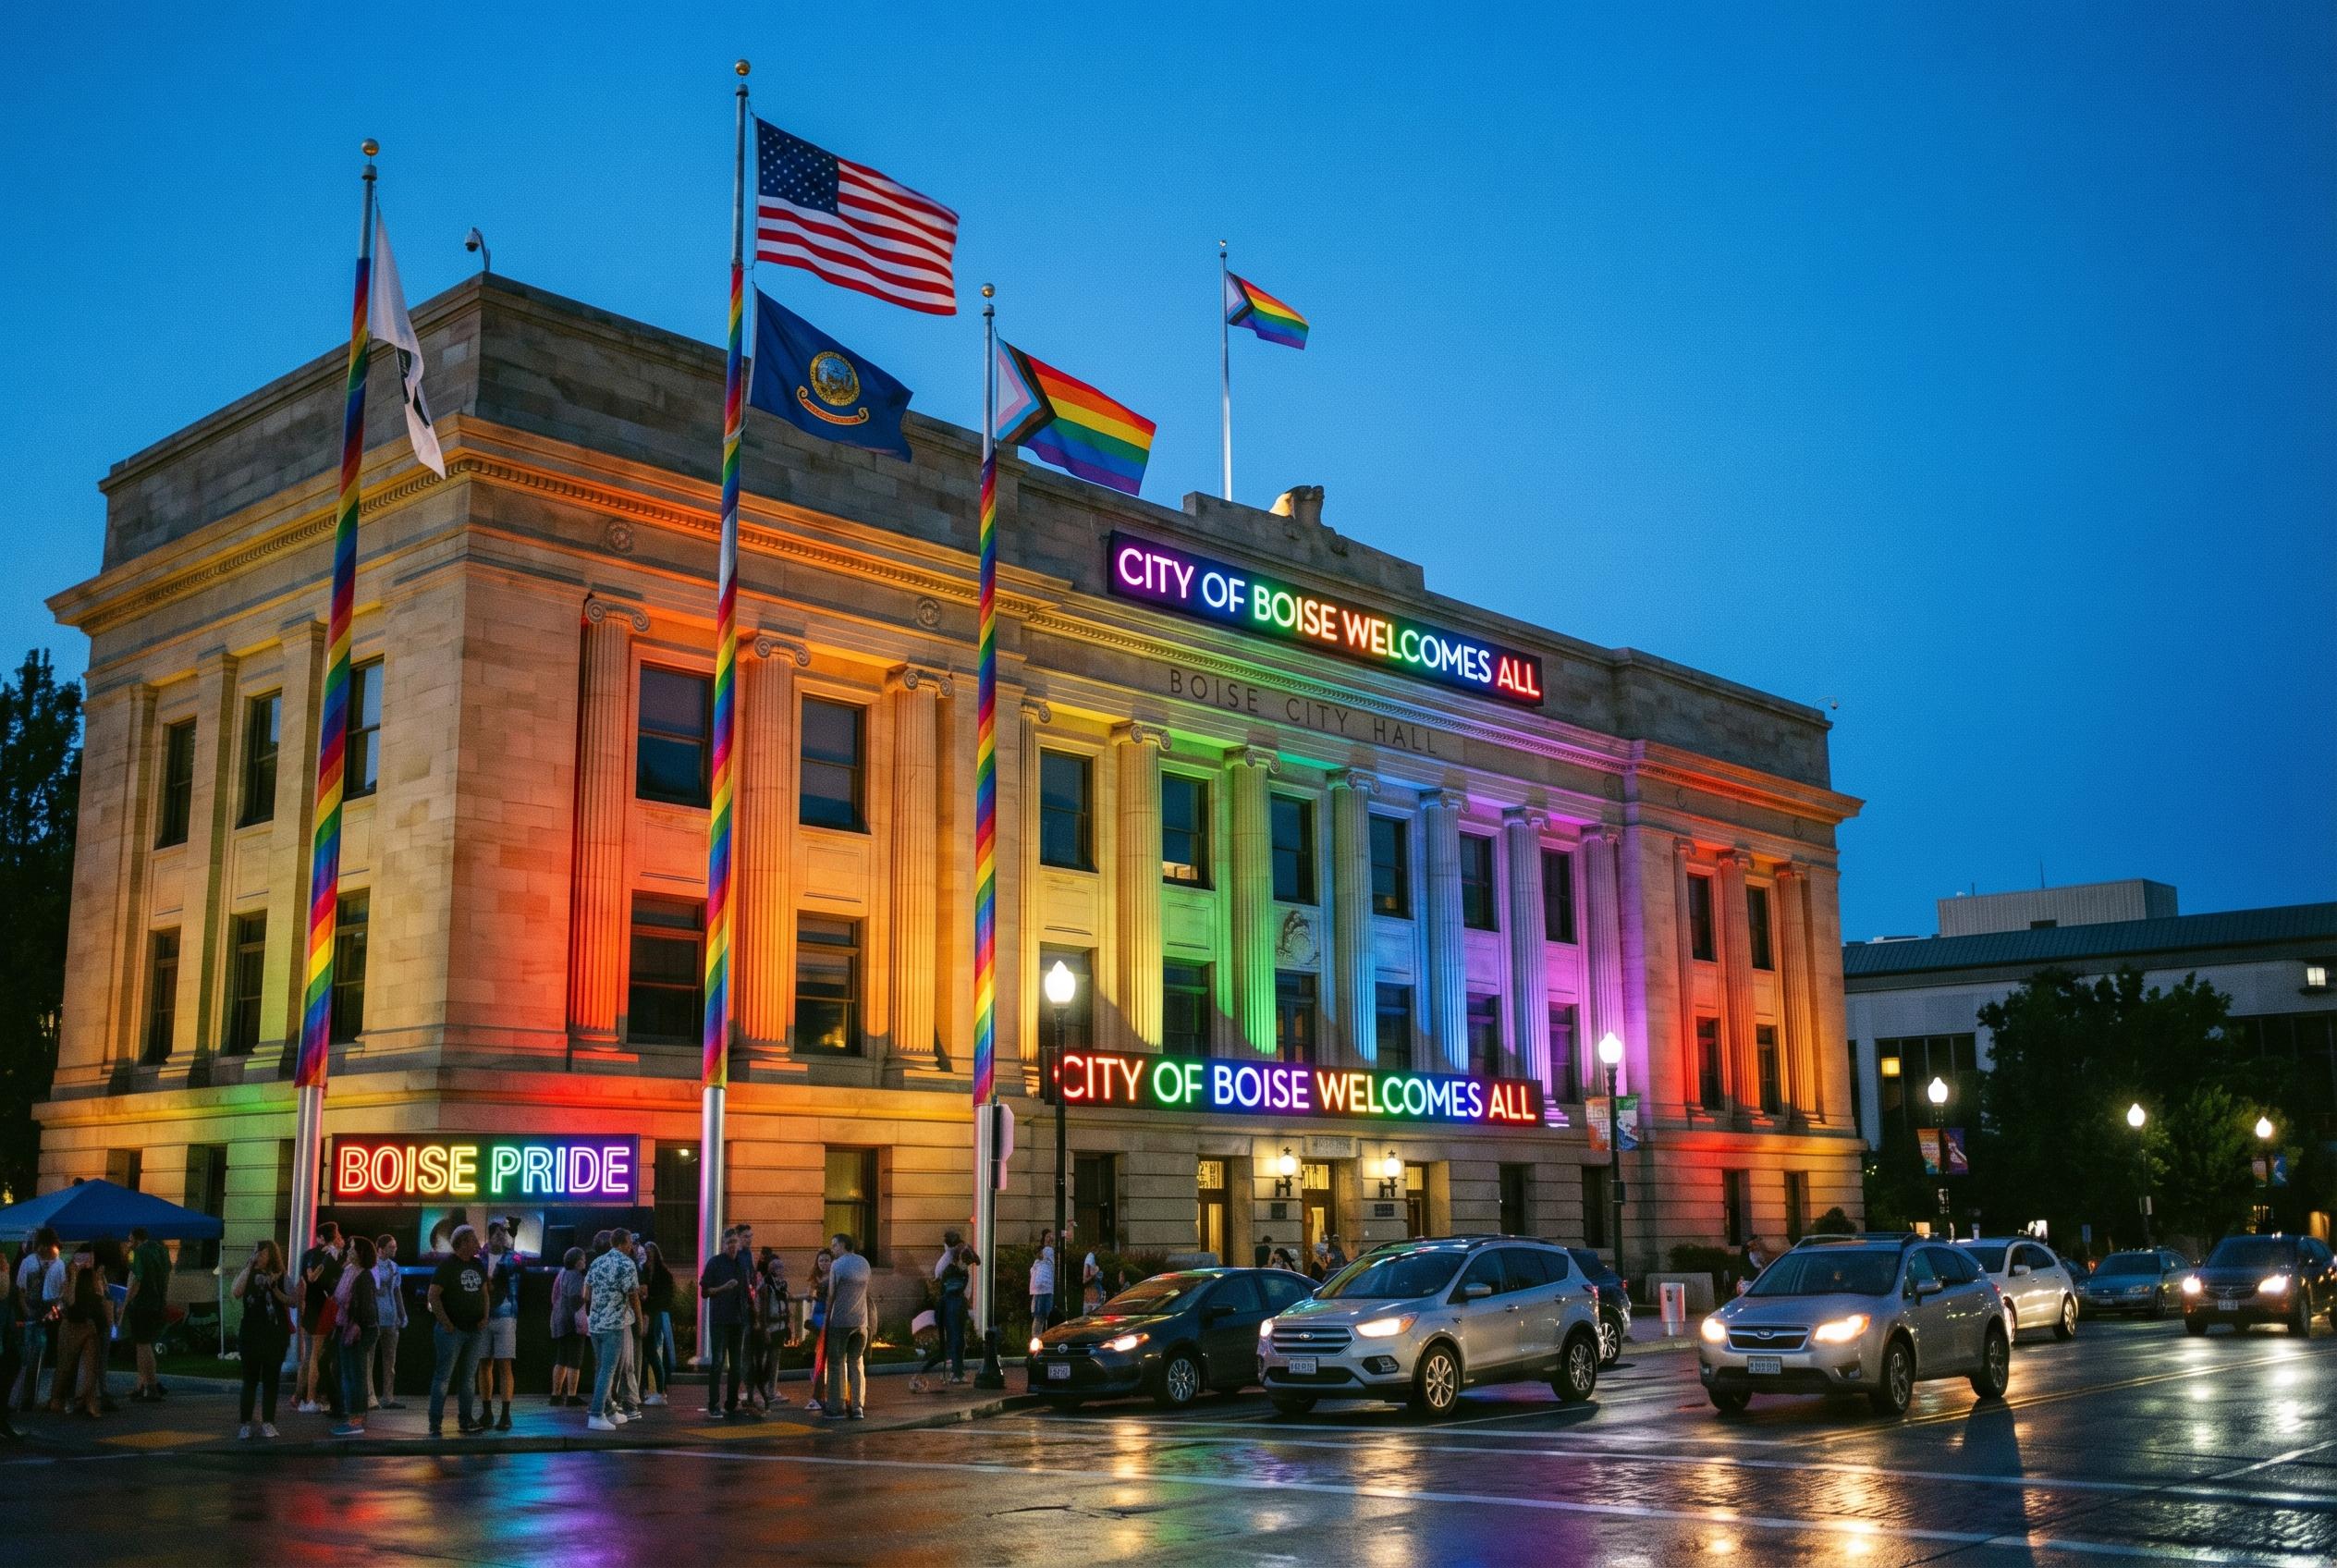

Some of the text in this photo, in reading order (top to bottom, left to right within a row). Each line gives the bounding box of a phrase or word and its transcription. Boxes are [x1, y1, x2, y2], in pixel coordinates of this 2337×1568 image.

[1120, 548, 1539, 696] CITY OF BOISE WELCOMES ALL
[1170, 668, 1437, 754] BOISE CITY HALL
[1055, 1055, 1536, 1121] CITY OF BOISE WELCOMES ALL
[338, 1146, 630, 1193] BOISE PRIDE
